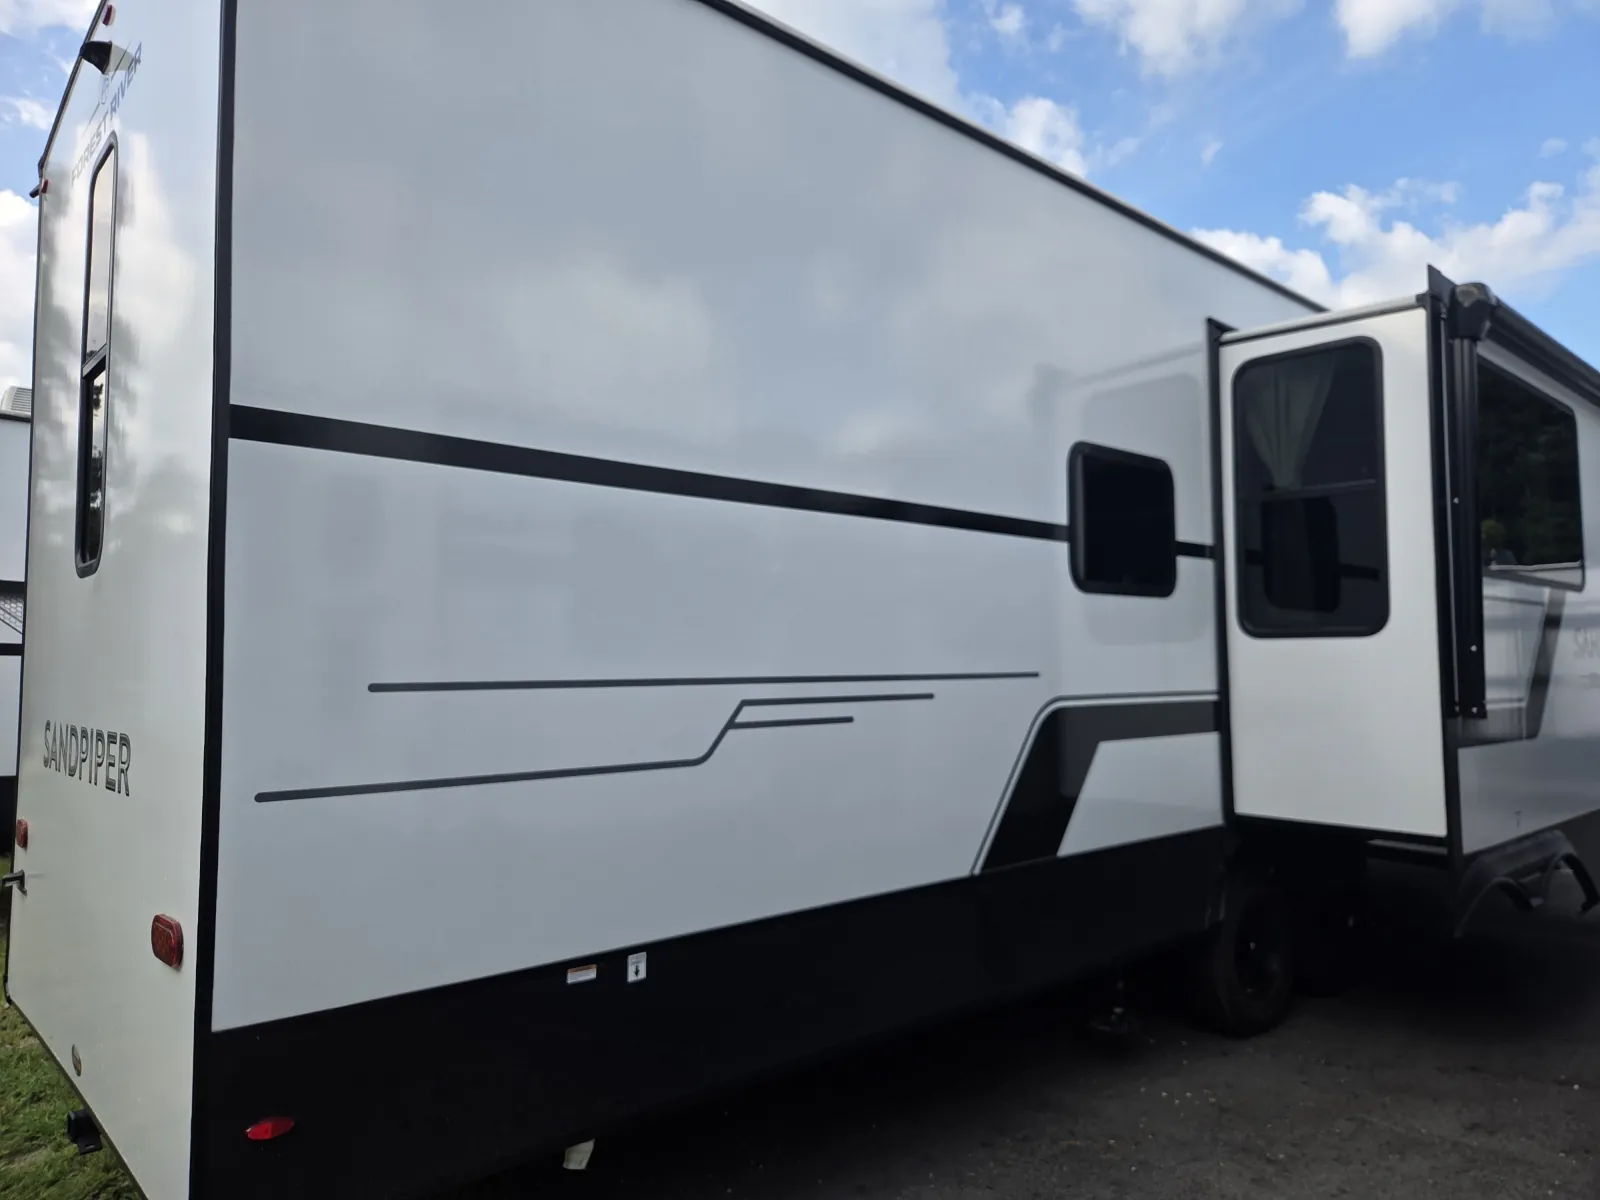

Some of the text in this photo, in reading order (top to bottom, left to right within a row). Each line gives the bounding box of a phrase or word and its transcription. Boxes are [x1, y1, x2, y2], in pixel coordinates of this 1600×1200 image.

[71, 41, 142, 188] FOREST RIVER
[43, 719, 131, 797] SANDPIPER
